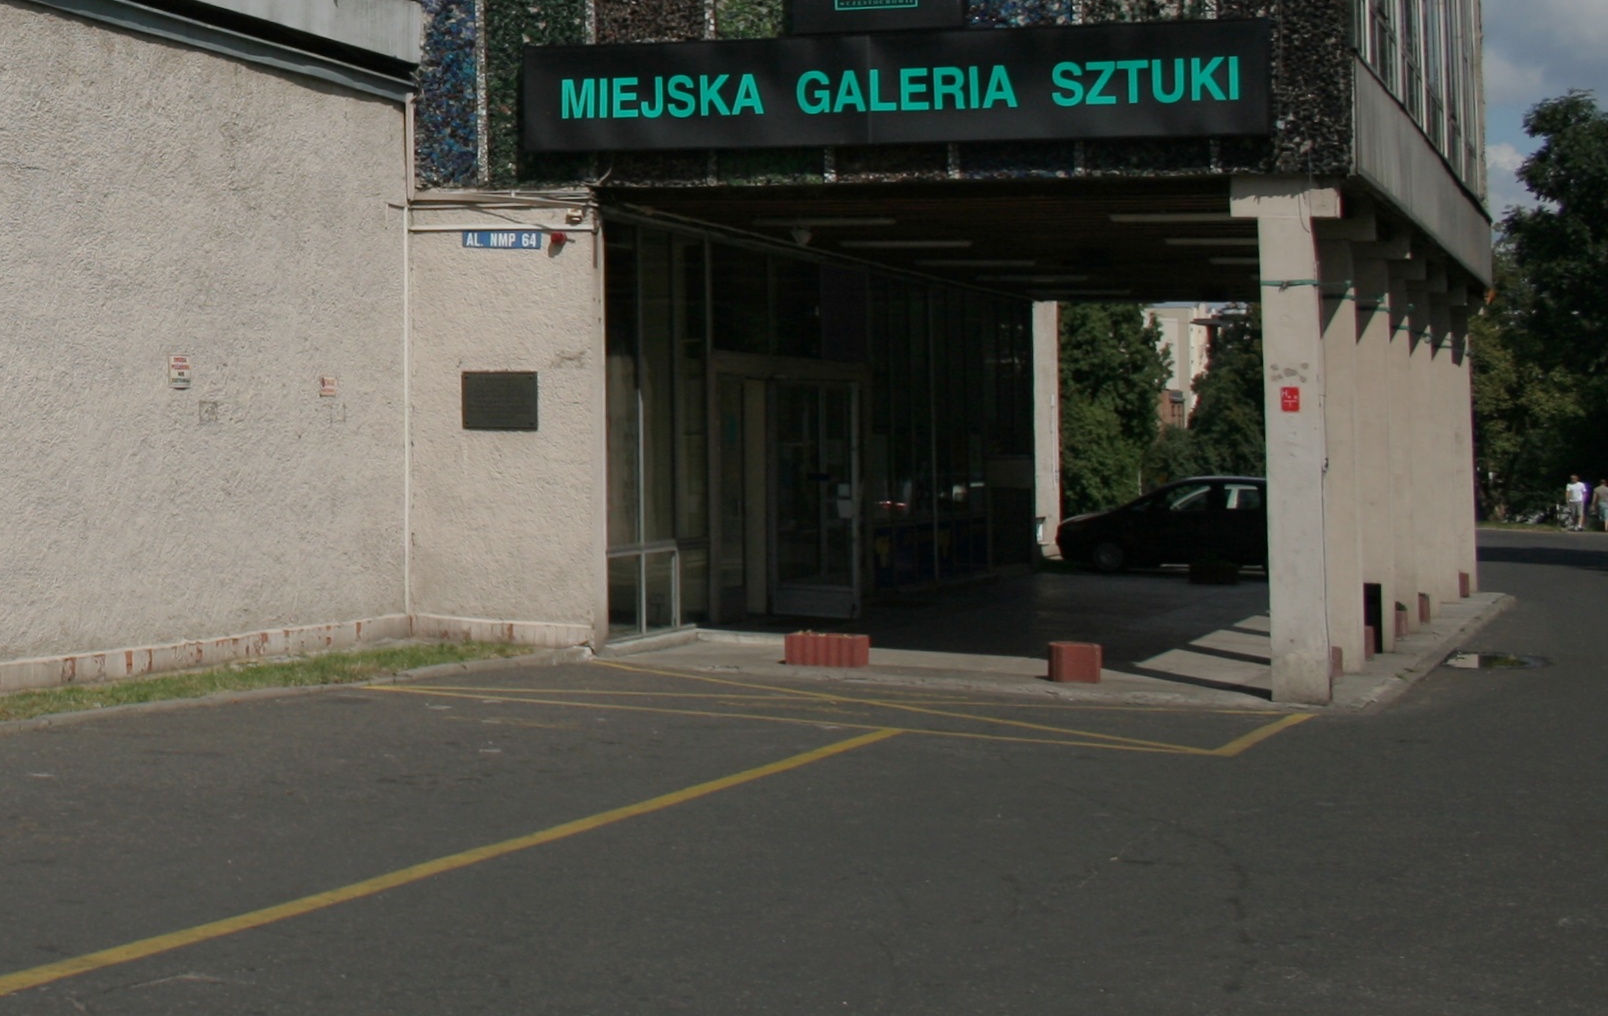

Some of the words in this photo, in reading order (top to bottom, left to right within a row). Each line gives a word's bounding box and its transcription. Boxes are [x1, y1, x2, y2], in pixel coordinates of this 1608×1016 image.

[561, 73, 764, 119] MIEJSKA
[796, 64, 1018, 115] GALERIA
[1051, 55, 1240, 107] SZTUKI
[466, 232, 483, 247] AL.
[490, 232, 516, 247] NMP
[521, 233, 537, 248] 64
